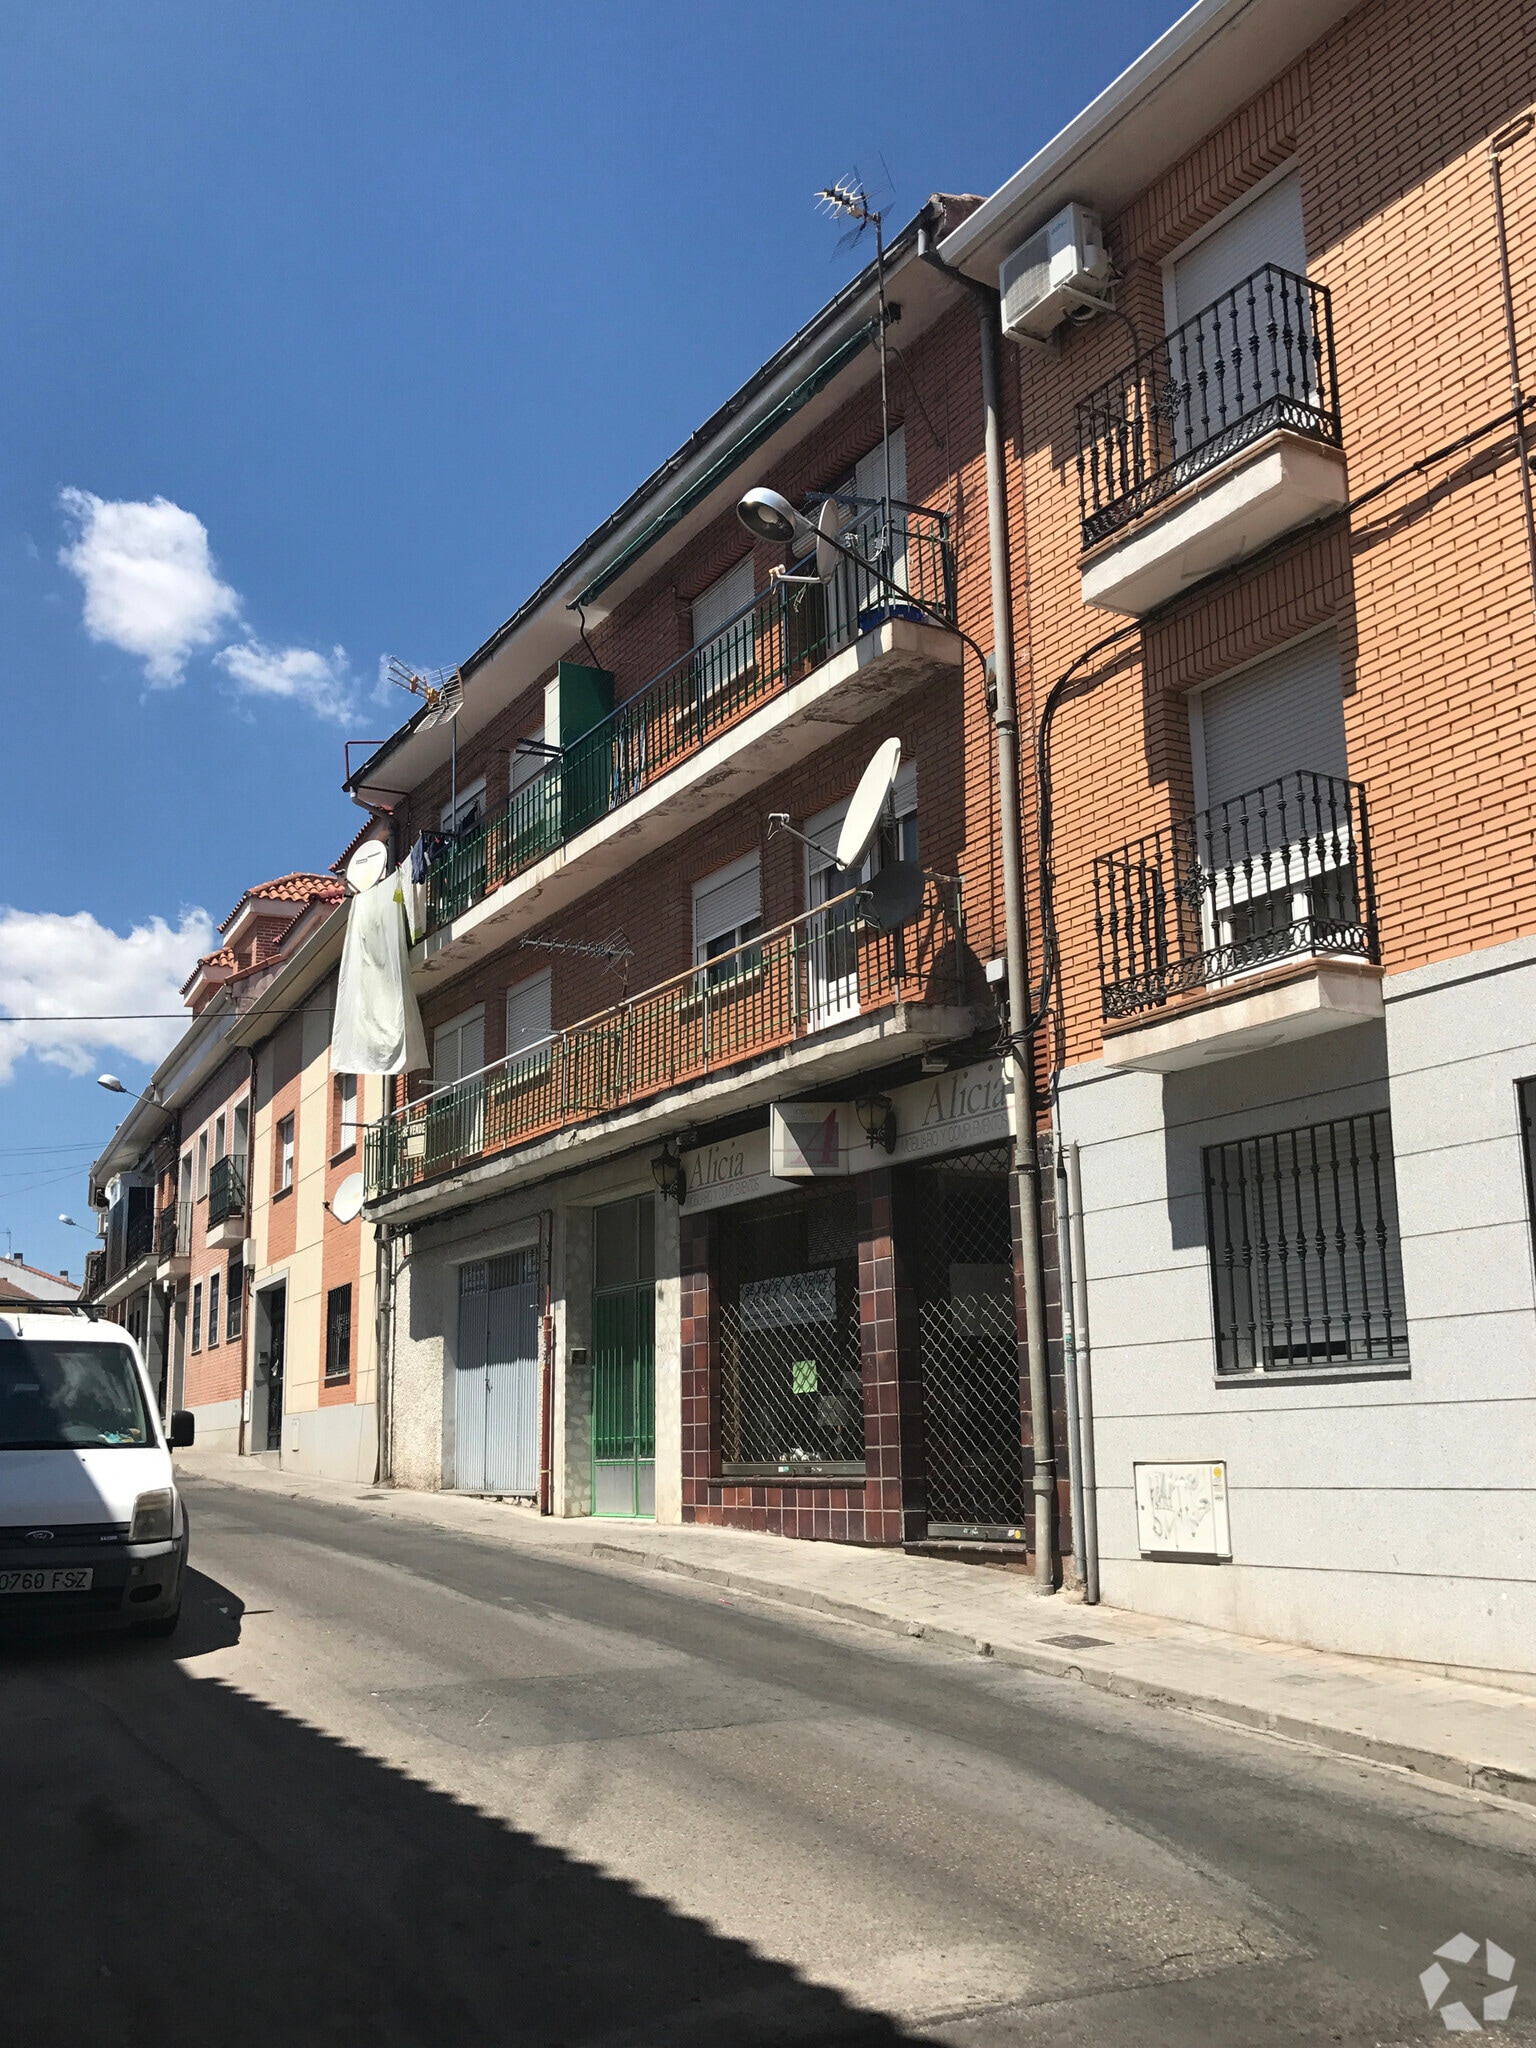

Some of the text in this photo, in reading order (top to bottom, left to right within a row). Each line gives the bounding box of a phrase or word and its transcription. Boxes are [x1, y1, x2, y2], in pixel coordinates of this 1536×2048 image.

[921, 1064, 1007, 1126] Alicia
[948, 1112, 1008, 1142] COMPLEMENTOS
[688, 1141, 744, 1189] Alicia
[0, 1571, 88, 1591] 0760 FSZ
